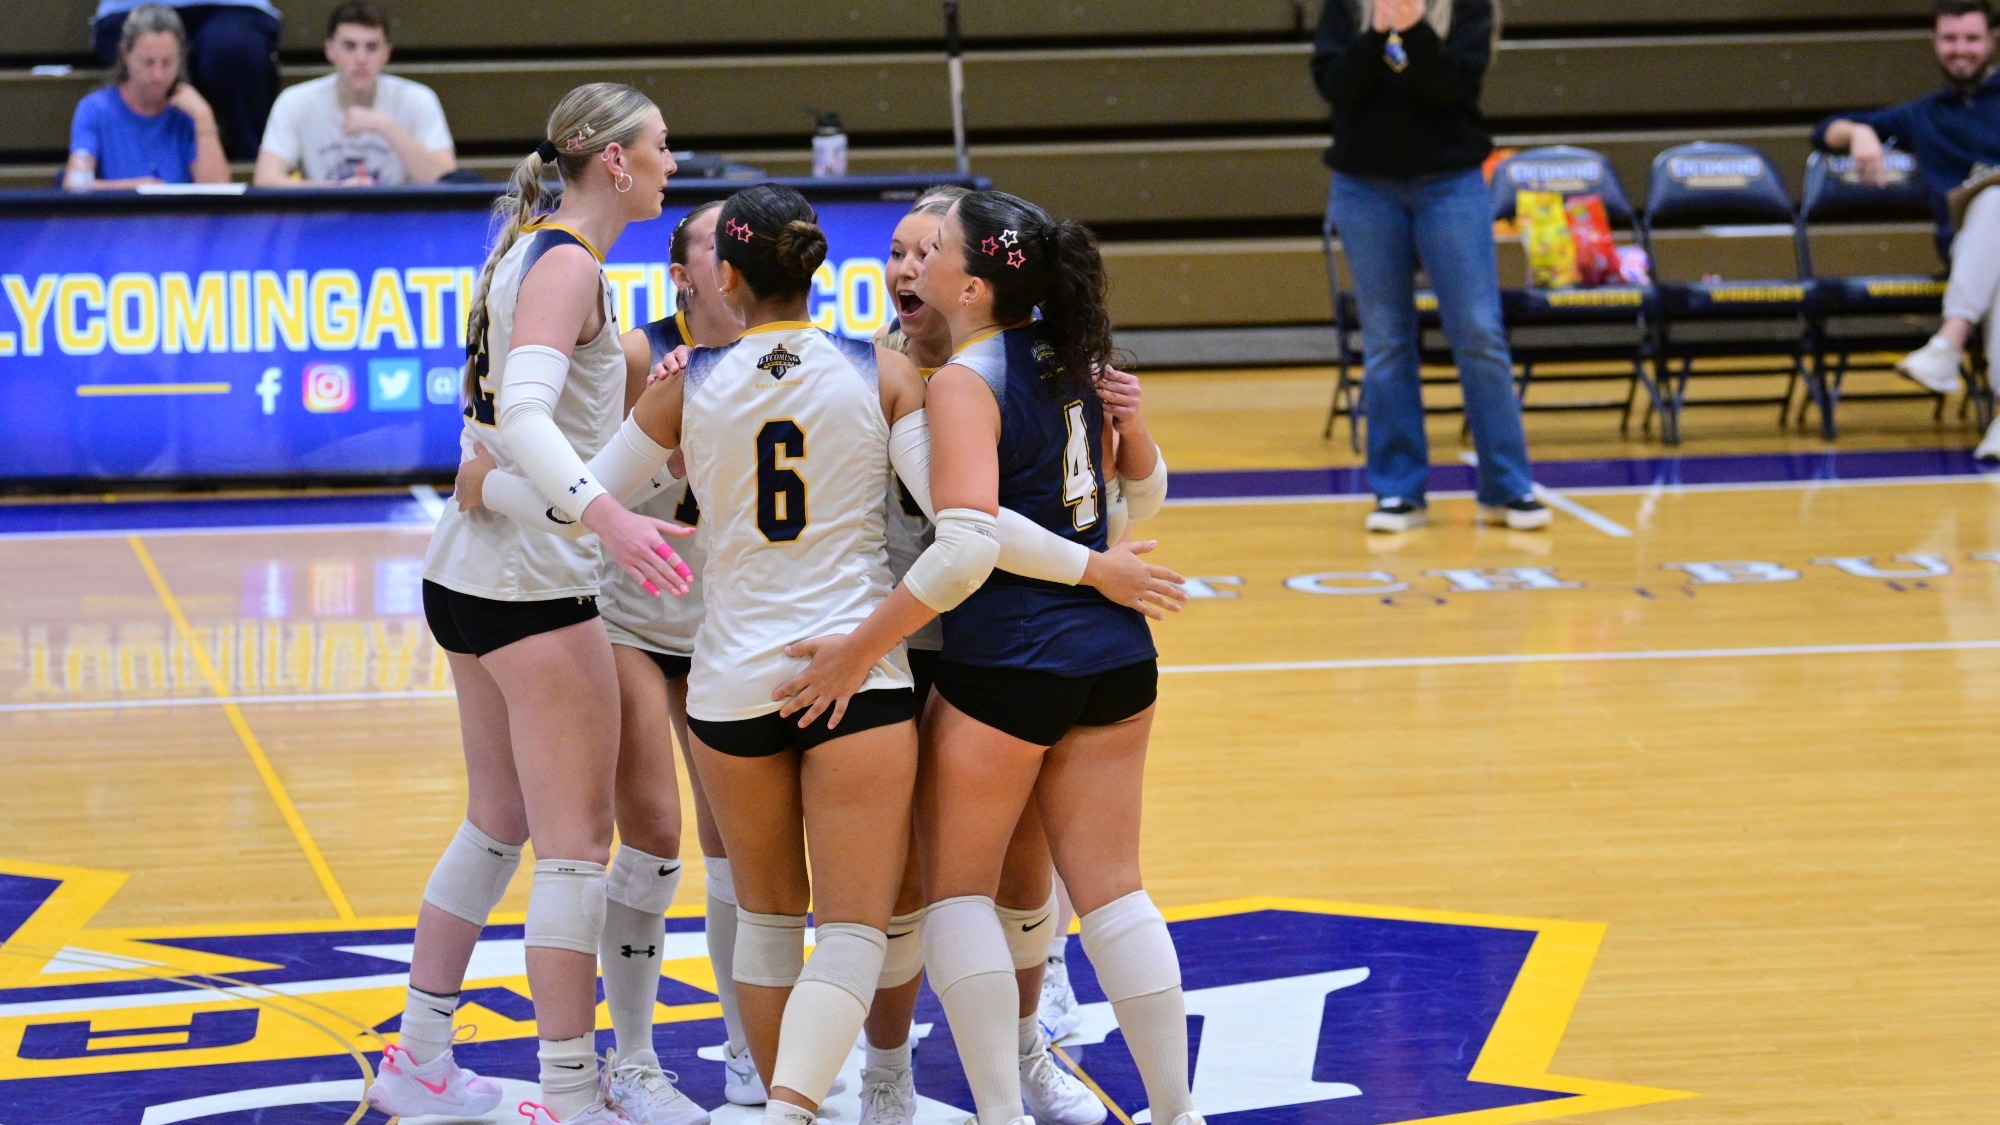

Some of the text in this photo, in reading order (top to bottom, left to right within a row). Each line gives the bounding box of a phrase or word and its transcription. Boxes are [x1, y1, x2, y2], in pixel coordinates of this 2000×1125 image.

[757, 353, 800, 366] LYCOMING
[754, 417, 810, 544] 6
[1063, 399, 1098, 532] 4
